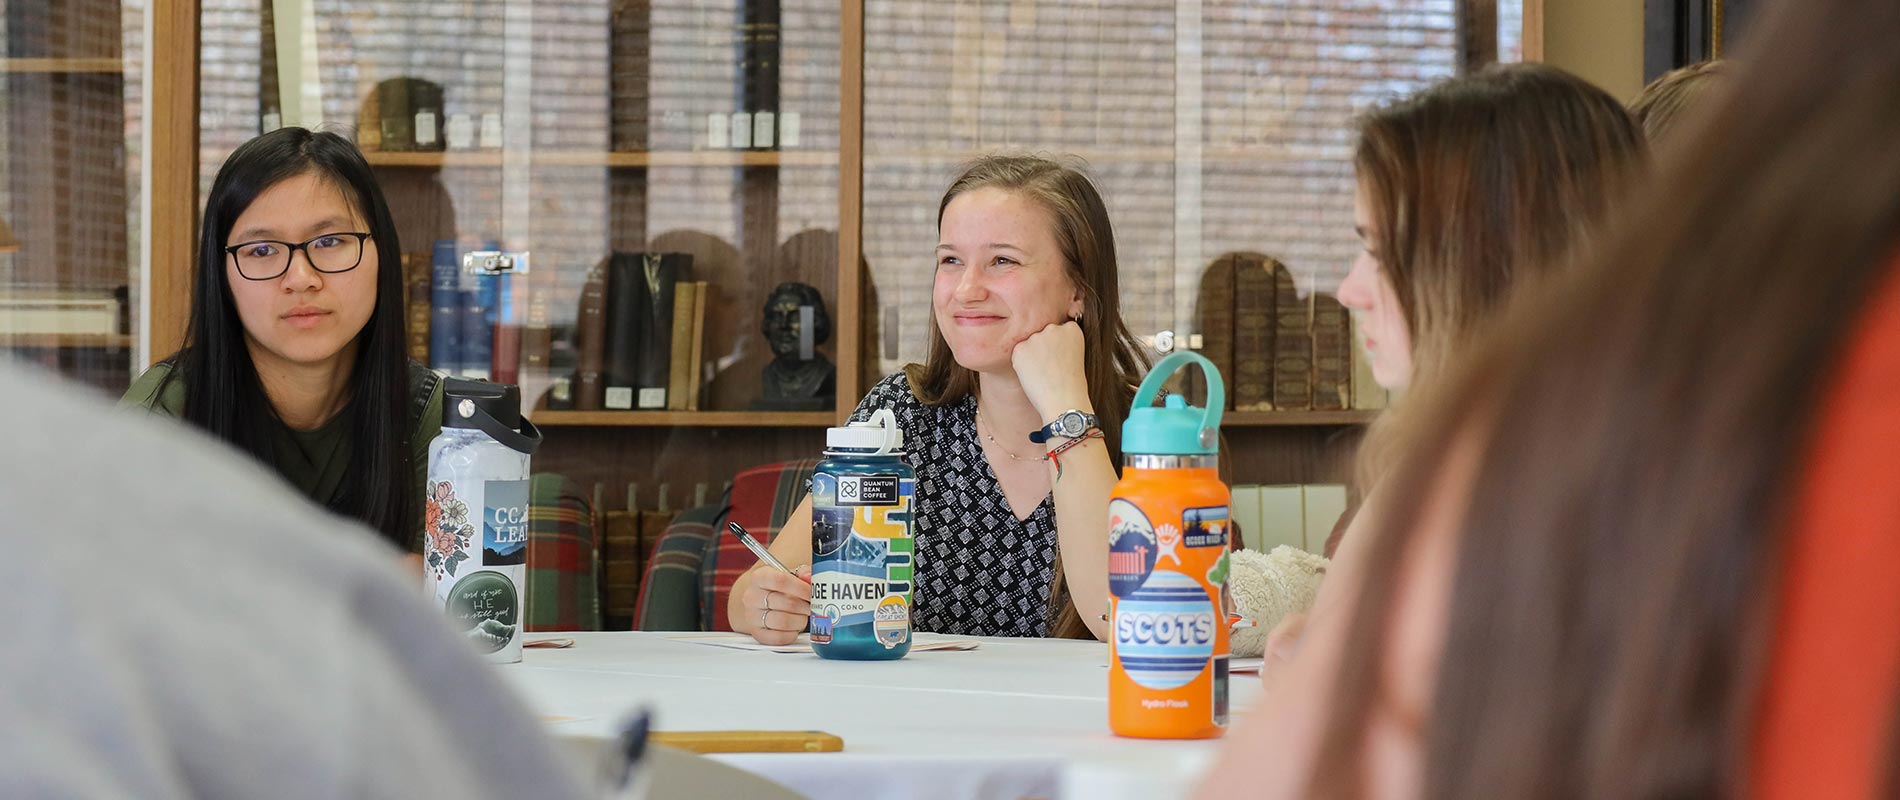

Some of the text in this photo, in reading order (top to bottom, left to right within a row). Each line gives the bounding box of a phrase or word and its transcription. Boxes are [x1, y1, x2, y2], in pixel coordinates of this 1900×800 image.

[832, 583, 885, 599] HAVEN
[473, 598, 494, 610] HE
[1119, 613, 1211, 644] SCOTS
